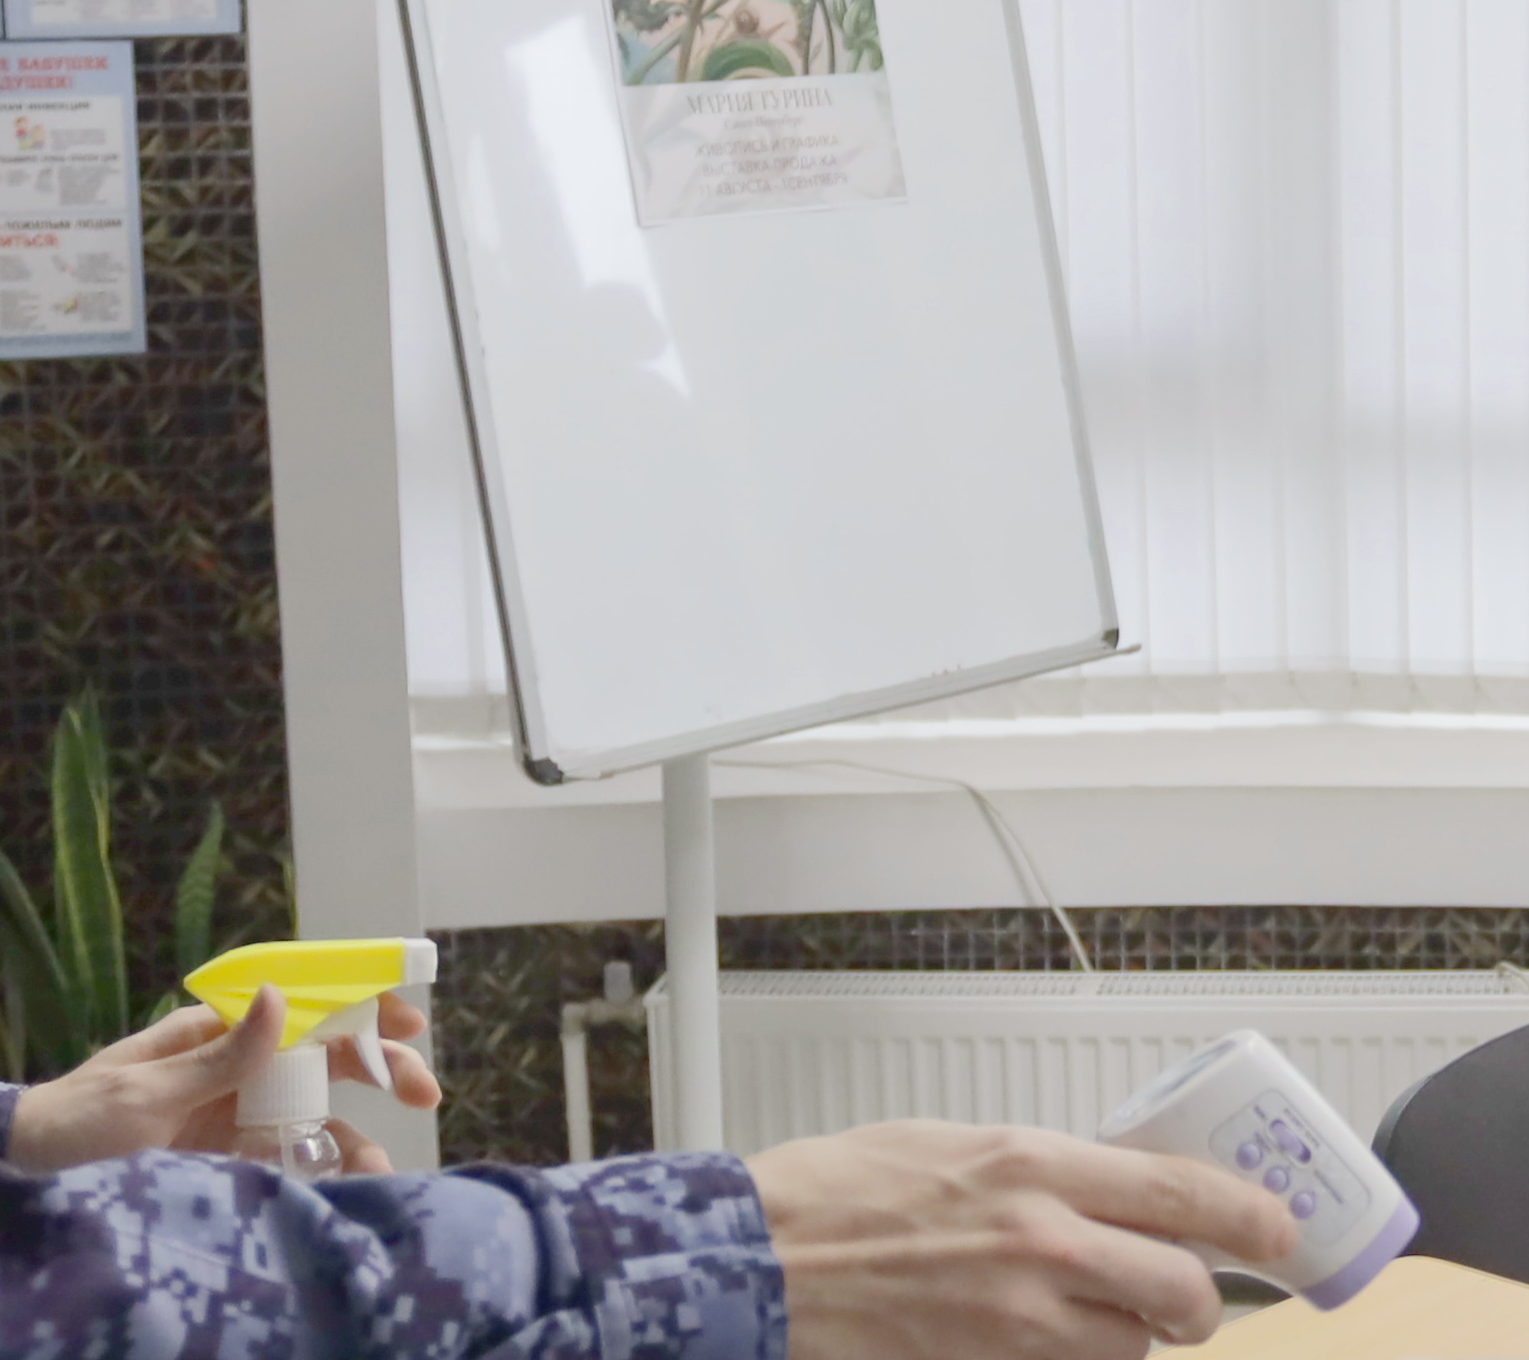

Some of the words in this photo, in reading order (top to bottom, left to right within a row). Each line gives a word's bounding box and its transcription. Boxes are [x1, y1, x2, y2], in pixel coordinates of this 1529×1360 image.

[687, 92, 753, 115] МАРИЯ
[760, 87, 833, 111] ТУРИНА
[695, 140, 768, 157] ЖИВОПИСЬ
[782, 134, 840, 151] ГРАФИКА
[715, 179, 771, 196] АВГУСТА
